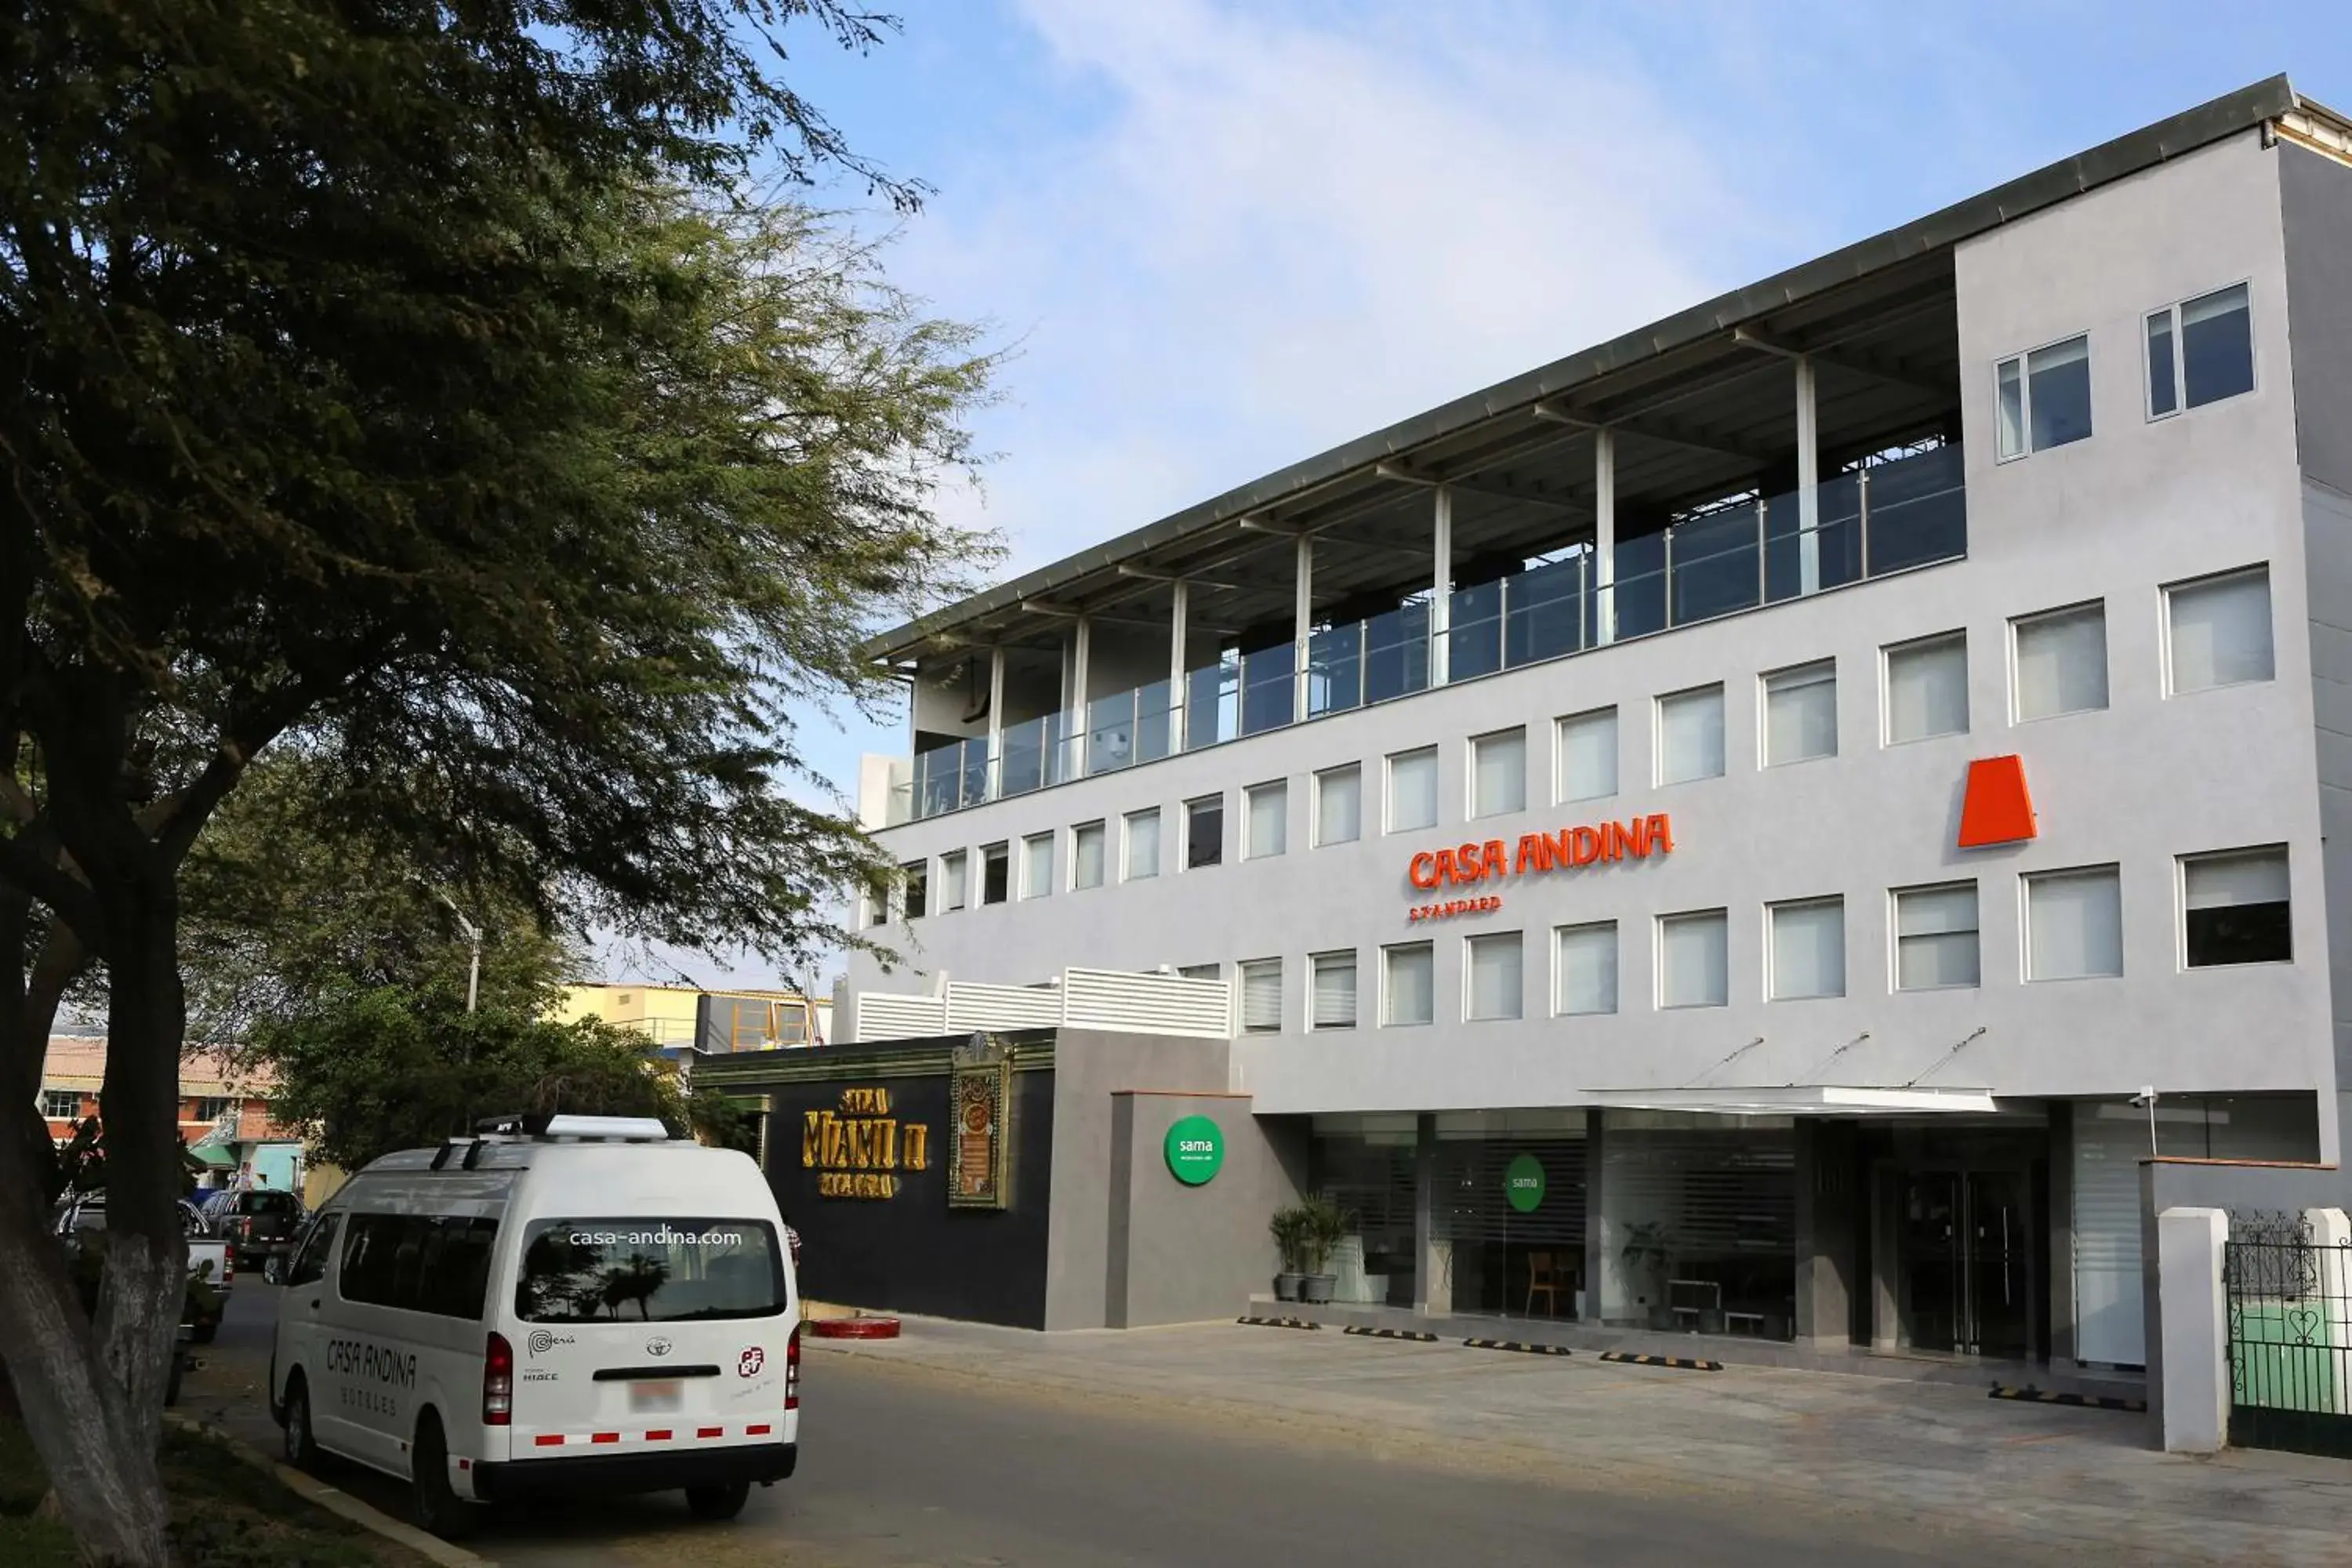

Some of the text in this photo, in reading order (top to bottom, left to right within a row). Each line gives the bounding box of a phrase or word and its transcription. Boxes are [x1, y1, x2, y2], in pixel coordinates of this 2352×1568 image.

[1410, 812, 1673, 890] CASA ANDINA
[1409, 895, 1502, 923] STANDARD
[1179, 1140, 1214, 1152] sama
[1512, 1178, 1537, 1189] sama
[570, 1223, 742, 1246] casa-andina.com
[327, 1338, 417, 1391] CASA ANDINA
